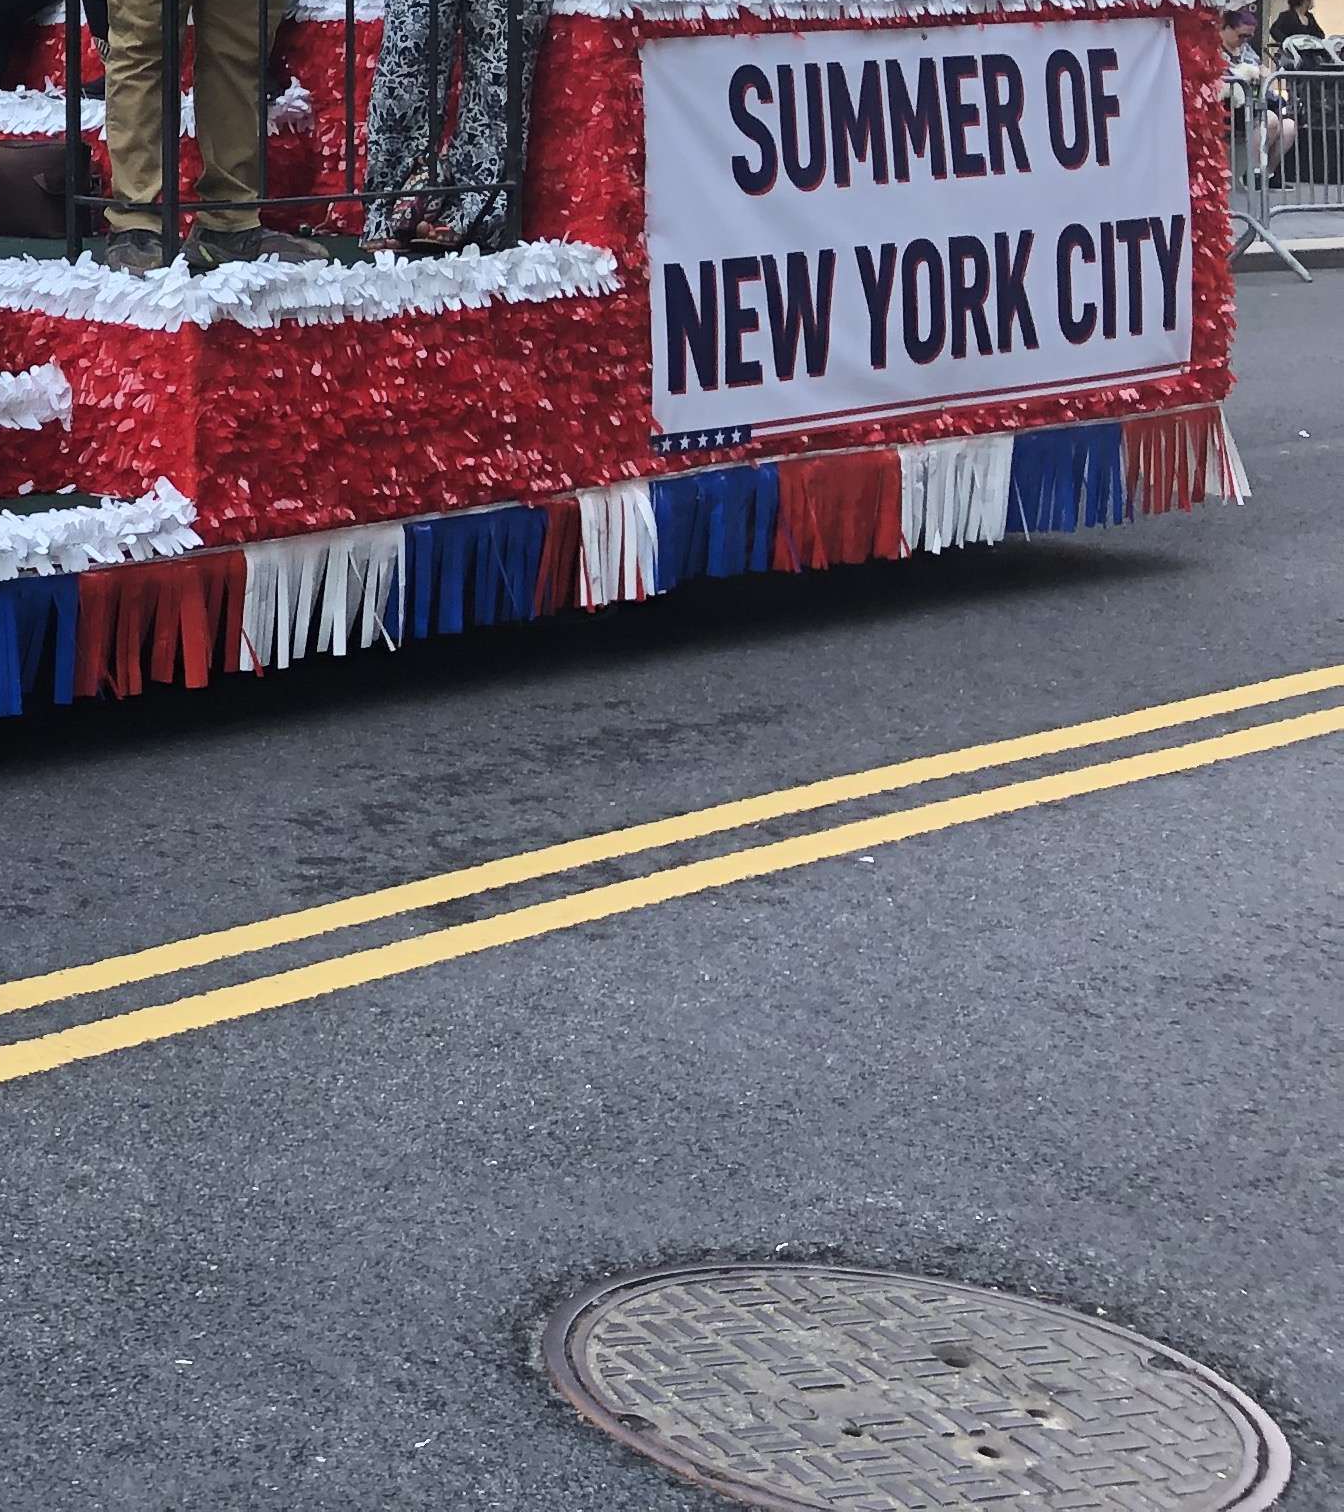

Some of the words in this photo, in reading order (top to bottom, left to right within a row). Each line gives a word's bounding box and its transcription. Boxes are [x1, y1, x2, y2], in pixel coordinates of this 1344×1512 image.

[727, 53, 1031, 197] SUMMER
[1045, 48, 1121, 171] OF
[663, 248, 837, 396] NEW
[854, 229, 1040, 370] YORK
[1056, 214, 1187, 346] CITY
